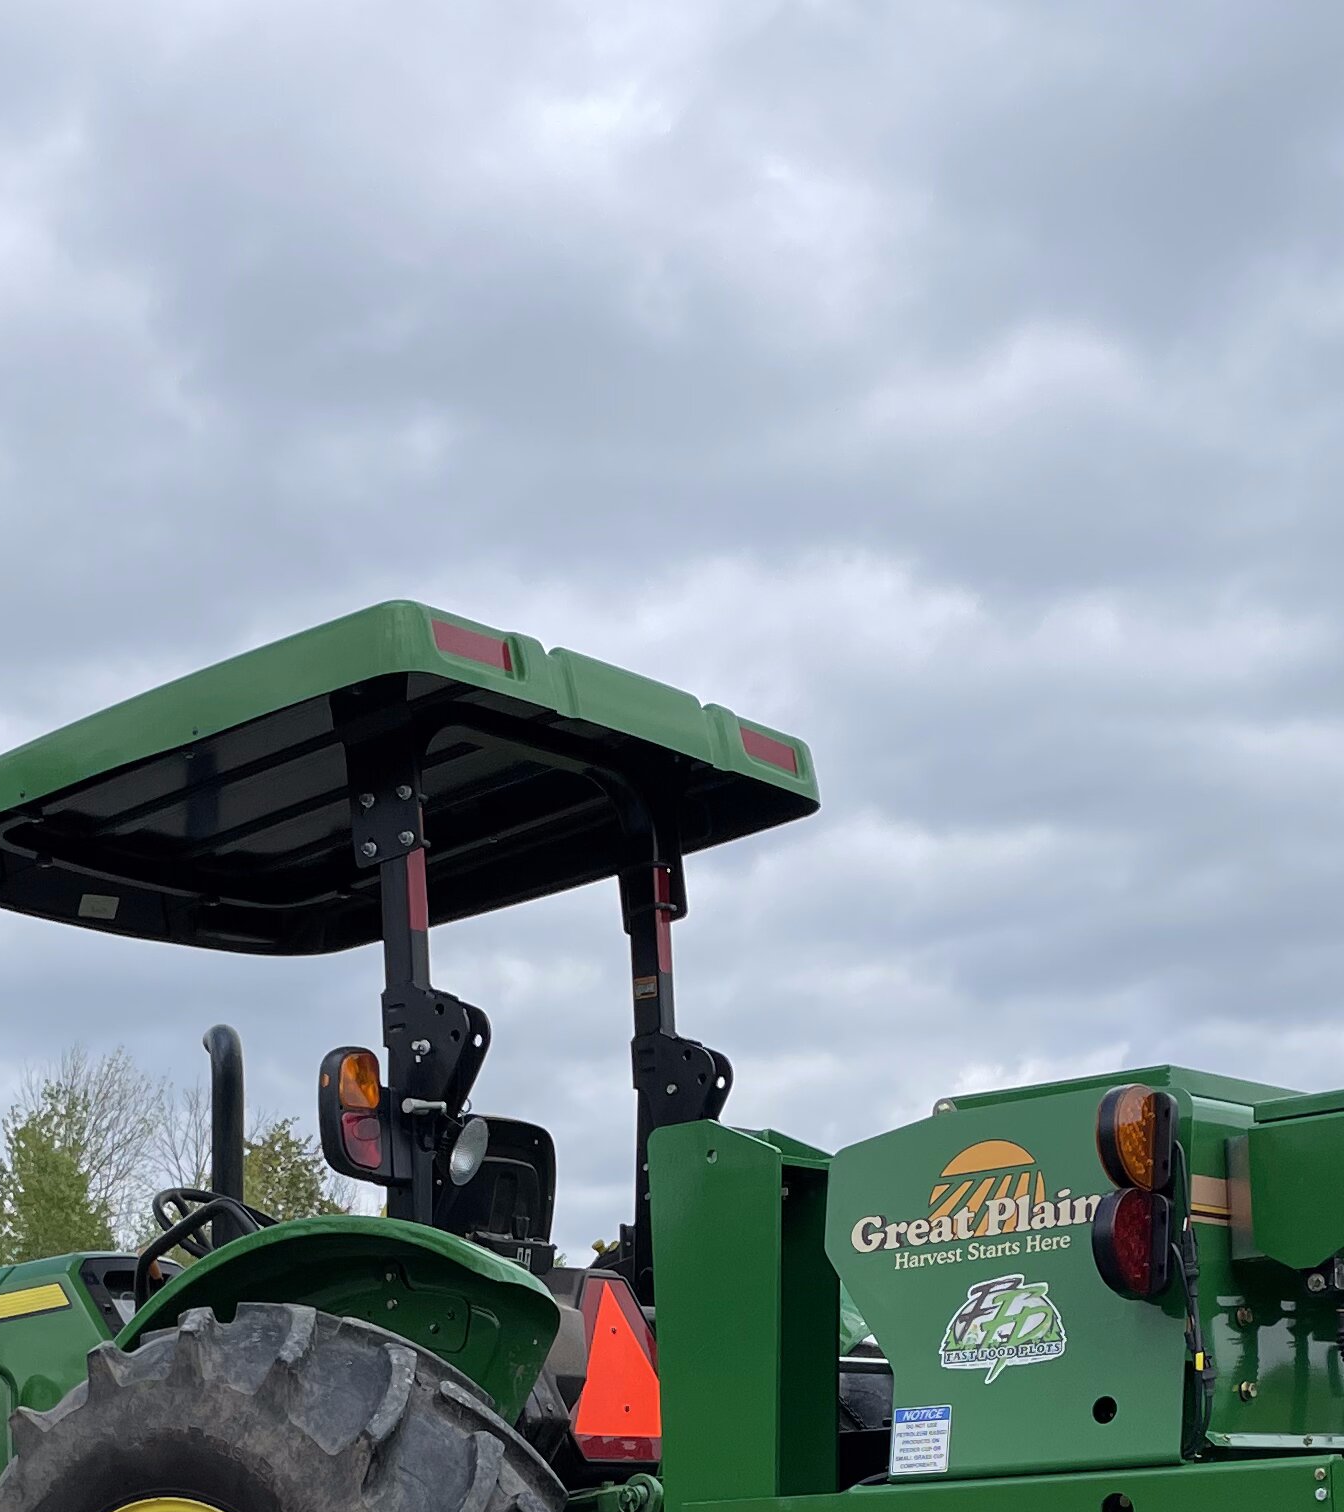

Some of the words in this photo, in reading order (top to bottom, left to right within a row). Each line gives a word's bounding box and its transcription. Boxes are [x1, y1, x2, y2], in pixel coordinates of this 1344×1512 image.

[850, 1205, 976, 1253] Great
[985, 1188, 1102, 1236] Plain
[894, 1246, 963, 1270] Harvest
[967, 1239, 1021, 1261] Starts
[1026, 1233, 1071, 1255] Here
[945, 1350, 976, 1362] FAST
[979, 1346, 1015, 1359] FOOD
[1019, 1342, 1062, 1355] PLOTS
[903, 1409, 944, 1421] NOTICE
